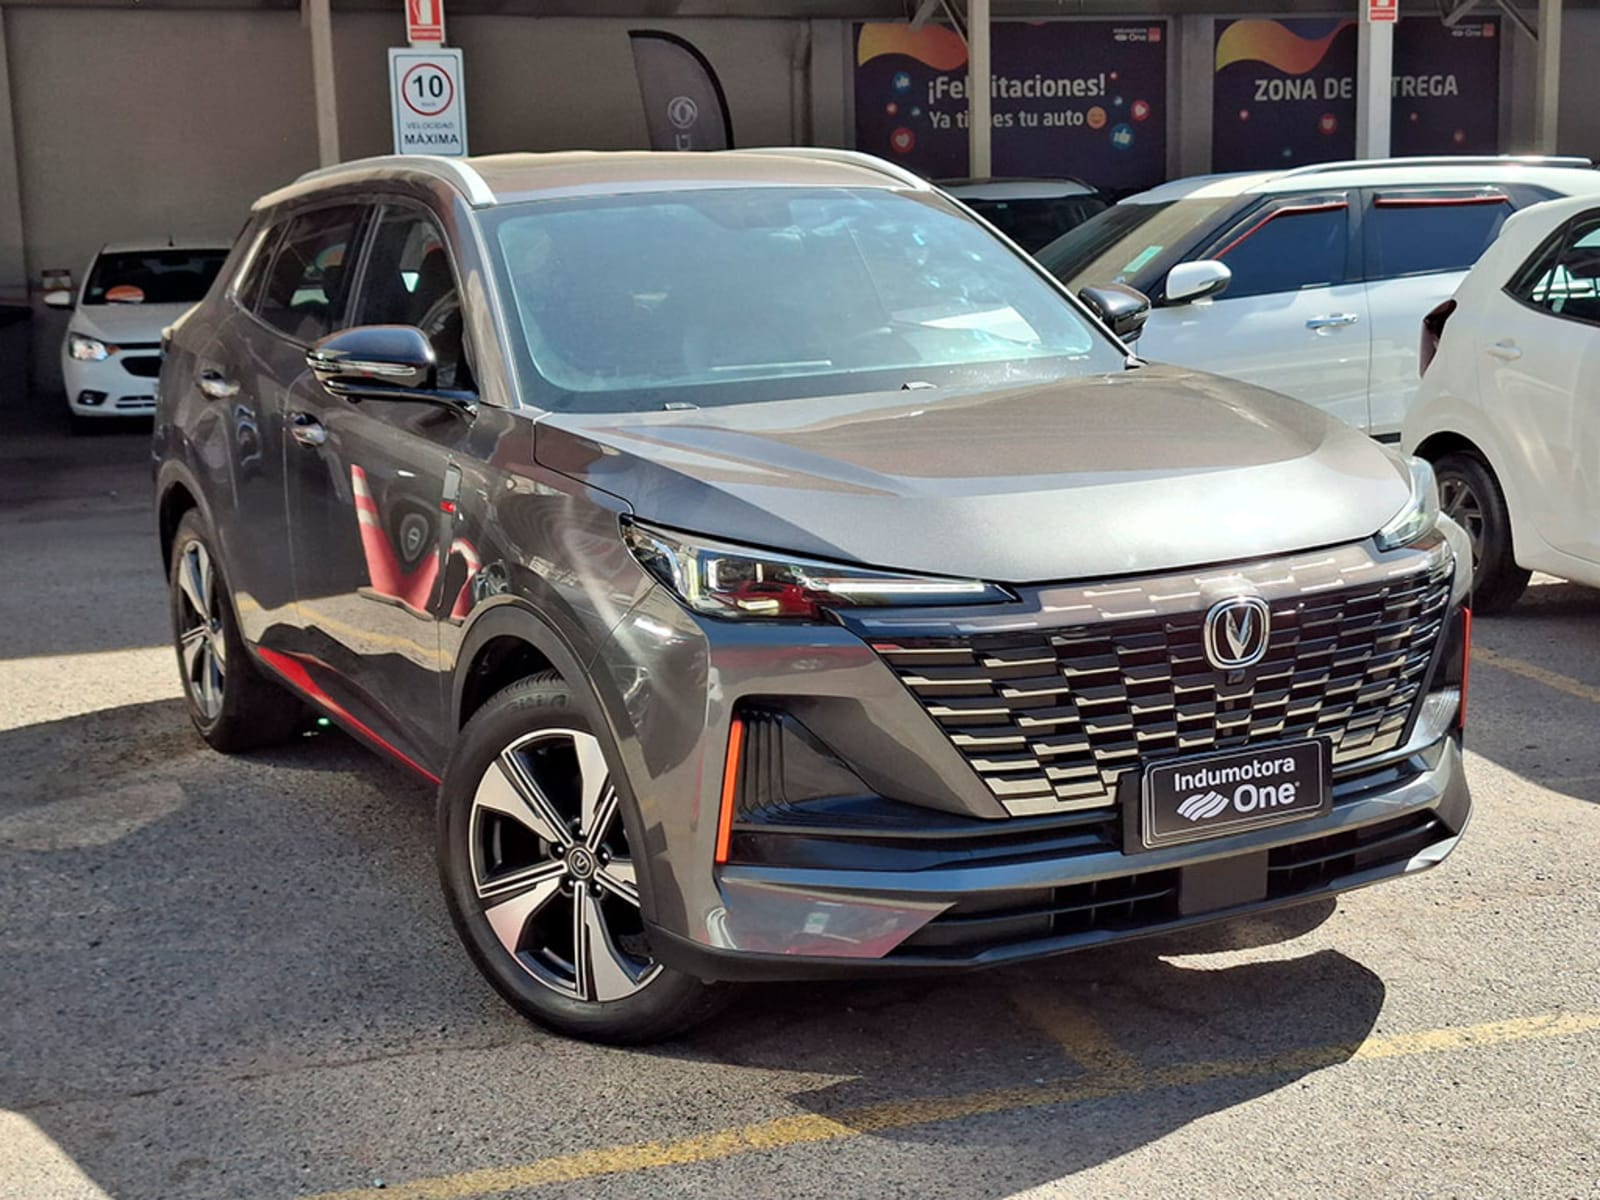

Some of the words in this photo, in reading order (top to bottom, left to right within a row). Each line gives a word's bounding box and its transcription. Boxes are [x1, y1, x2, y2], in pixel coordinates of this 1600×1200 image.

[412, 75, 444, 98] 10
[928, 73, 1106, 104] ¡Felitaciones!
[1254, 79, 1317, 101] ZONA
[1324, 77, 1353, 98] DE
[1390, 75, 1458, 97] TREGA
[406, 121, 455, 131] VELOCIDAD
[929, 112, 950, 128] Ya
[956, 110, 1013, 128] ties
[1020, 111, 1038, 127] tu
[1043, 109, 1085, 126] auto
[404, 133, 459, 145] MÁXIMA
[1174, 757, 1296, 791] Indumotora
[1233, 782, 1296, 812] One
